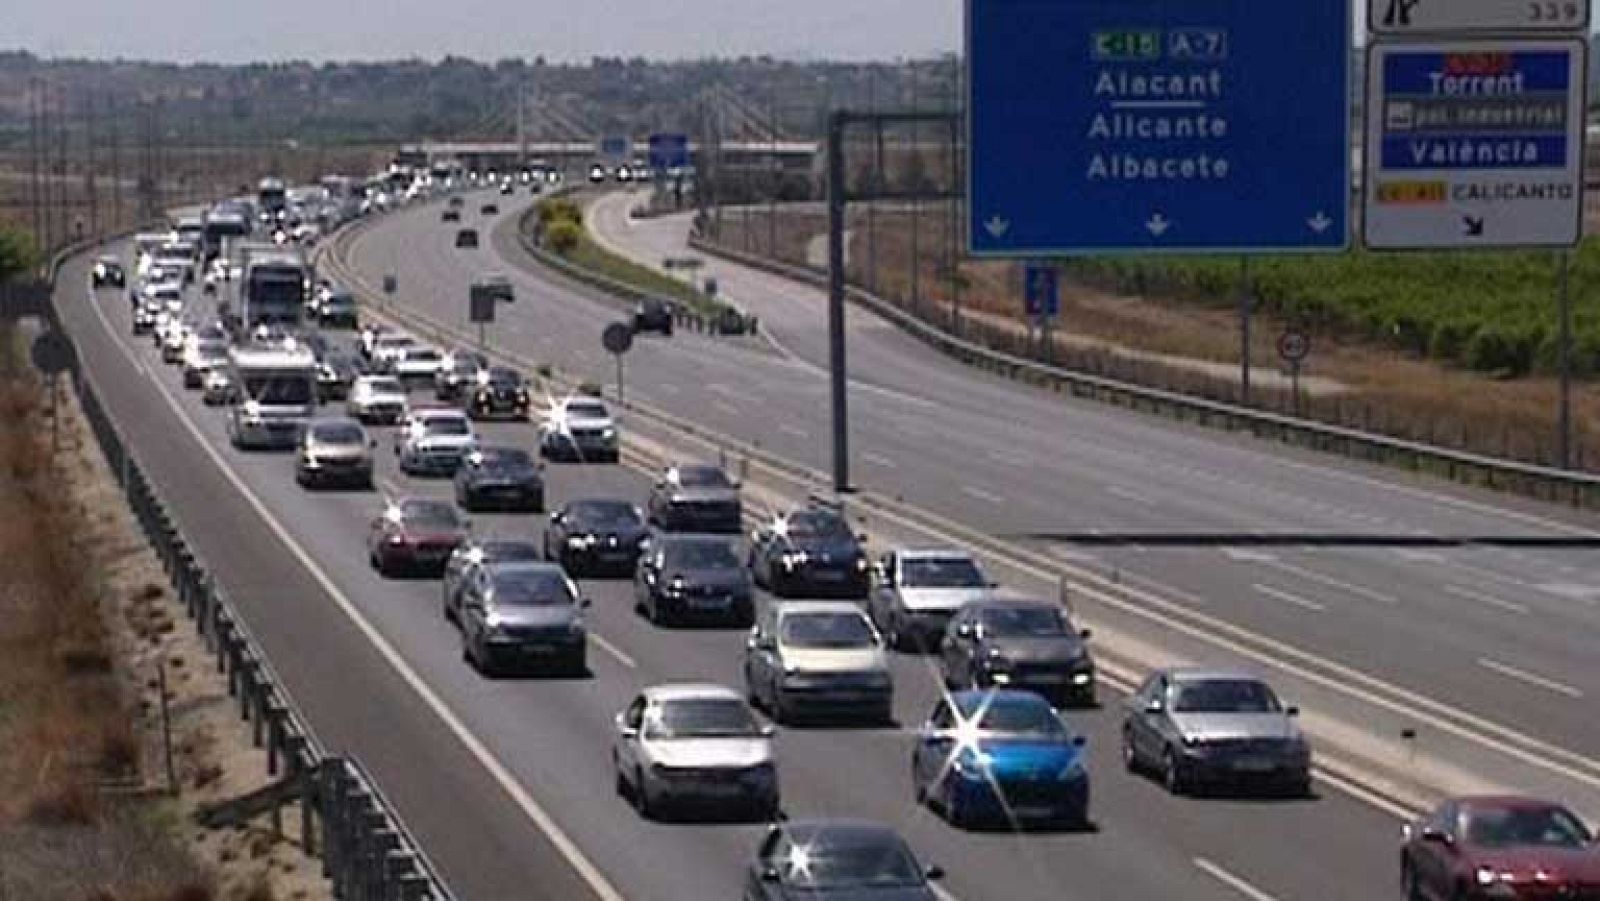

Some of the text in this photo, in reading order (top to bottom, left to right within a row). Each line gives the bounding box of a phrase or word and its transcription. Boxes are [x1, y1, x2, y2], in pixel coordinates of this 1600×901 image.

[1172, 32, 1220, 56] A-7
[1095, 70, 1221, 95] Alacant
[1427, 71, 1524, 97] Torrent
[1087, 111, 1228, 138] Alicante
[1087, 152, 1229, 180] Albacete
